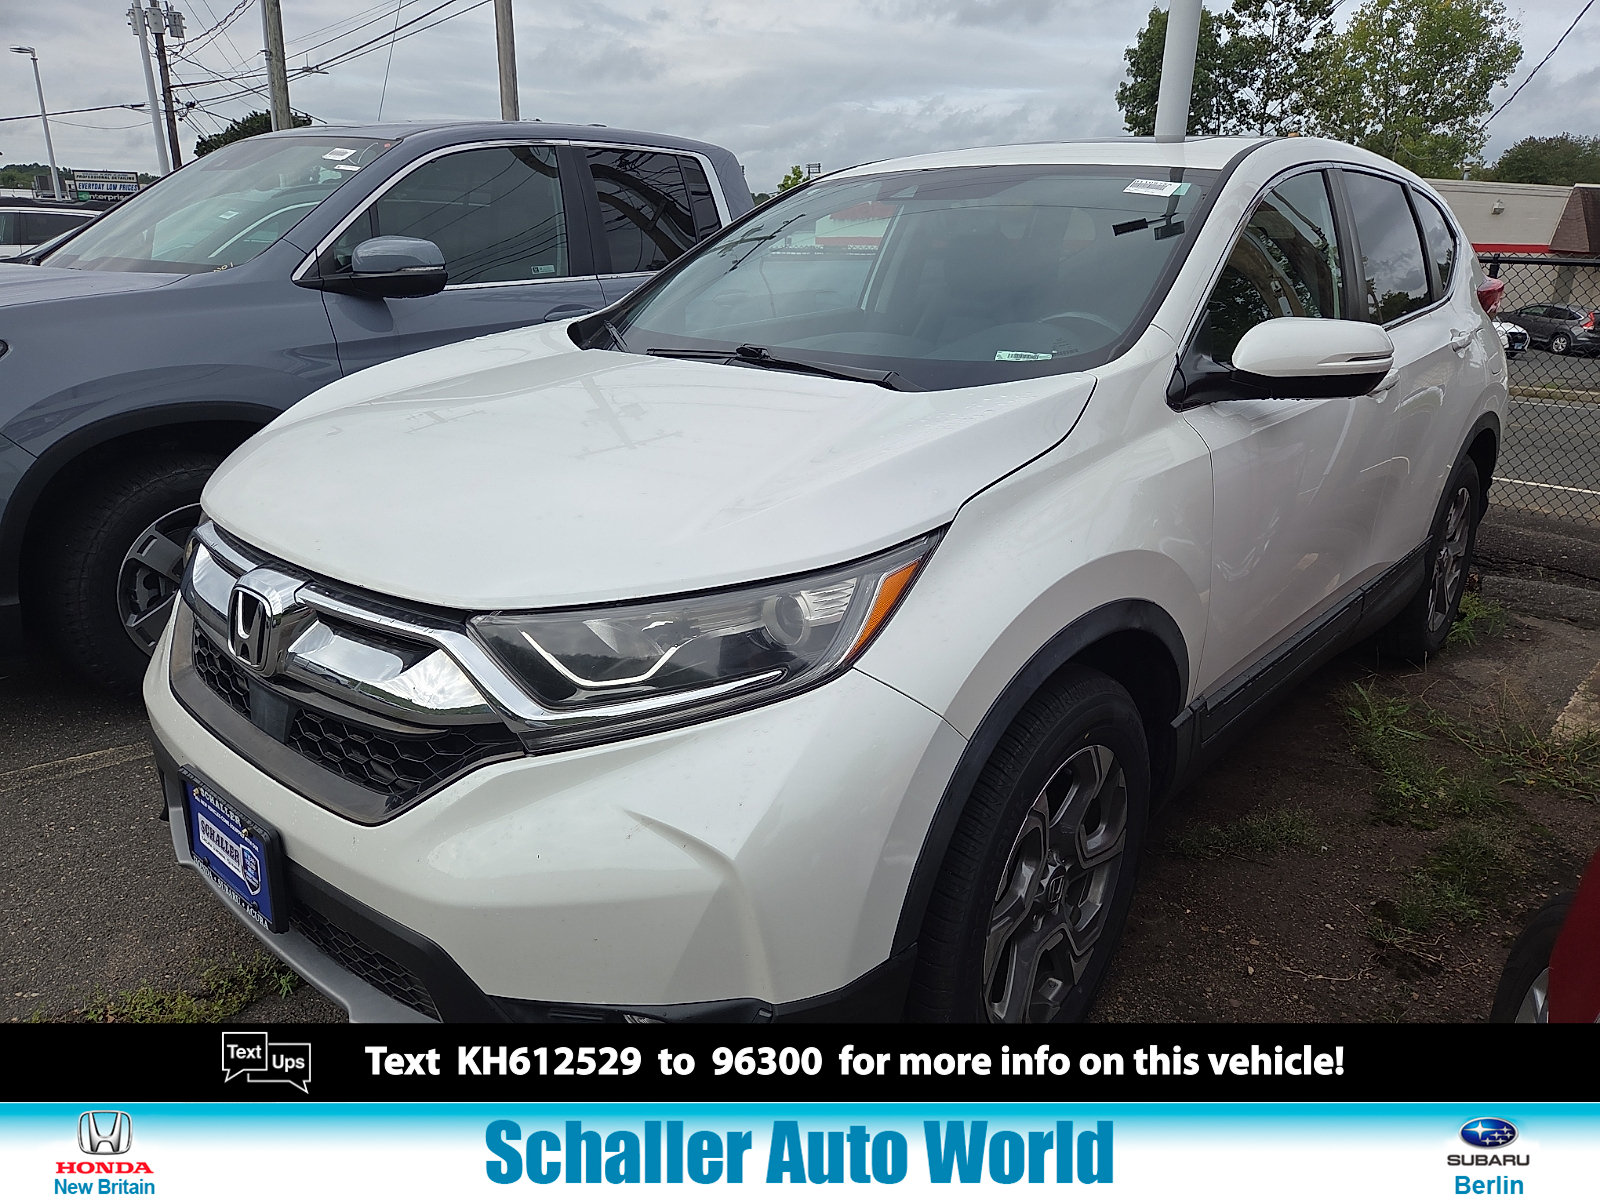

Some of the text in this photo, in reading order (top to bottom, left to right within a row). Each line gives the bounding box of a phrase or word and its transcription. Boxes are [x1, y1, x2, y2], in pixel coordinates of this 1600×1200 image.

[200, 787, 242, 828] SCHALLER
[200, 820, 241, 867] SCHALLER
[246, 904, 269, 930] ACURA
